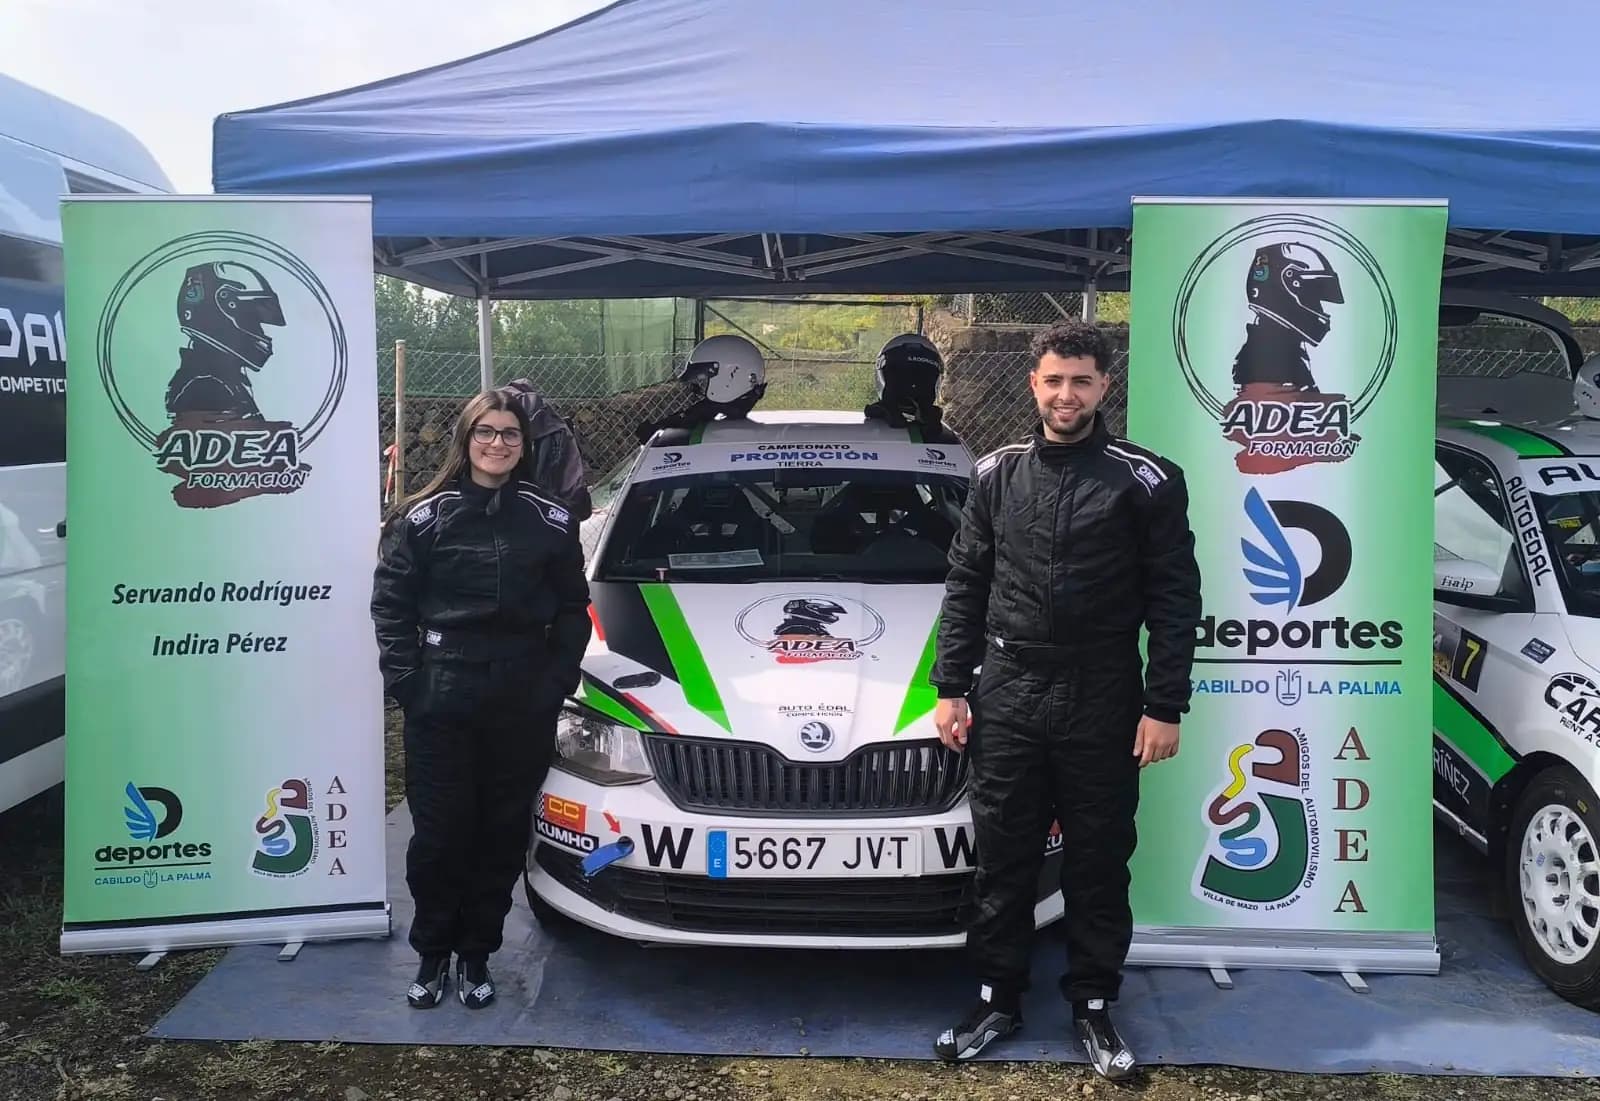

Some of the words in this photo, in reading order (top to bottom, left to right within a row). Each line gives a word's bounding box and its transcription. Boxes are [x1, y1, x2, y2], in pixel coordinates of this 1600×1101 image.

[0, 376, 66, 394] OMPETIC
[1220, 402, 1350, 438] ADEA
[152, 431, 297, 468] ADEA
[731, 450, 879, 462] PROMOCIÓN
[1250, 439, 1356, 457] FORMACIÓN
[188, 469, 306, 488] FORMACIÓN
[112, 582, 215, 604] Servando
[220, 580, 332, 607] Rodríguez
[152, 633, 219, 656] Indira
[226, 632, 288, 653] Pérez
[768, 640, 856, 651] ADEA
[1196, 616, 1403, 655] deportes
[1461, 639, 1480, 679] 7
[1307, 681, 1332, 694] LA
[1338, 681, 1402, 694] PALMA
[1560, 716, 1585, 735] RENT
[1292, 727, 1310, 771] AMIGOS
[1301, 773, 1310, 794] DEL
[537, 818, 594, 851] KUMHO
[641, 824, 694, 868] W
[1303, 798, 1320, 888] AUTOMOVILISMO
[95, 842, 211, 864] deportes
[714, 858, 722, 868] E
[734, 837, 826, 870] 5667
[842, 836, 909, 869] JVT
[934, 826, 976, 868] W
[95, 876, 141, 885] CABILDO
[160, 873, 174, 882] LA
[176, 871, 211, 881] PALMA
[1203, 890, 1224, 904] VILLA
[1277, 894, 1301, 910] PALMA
